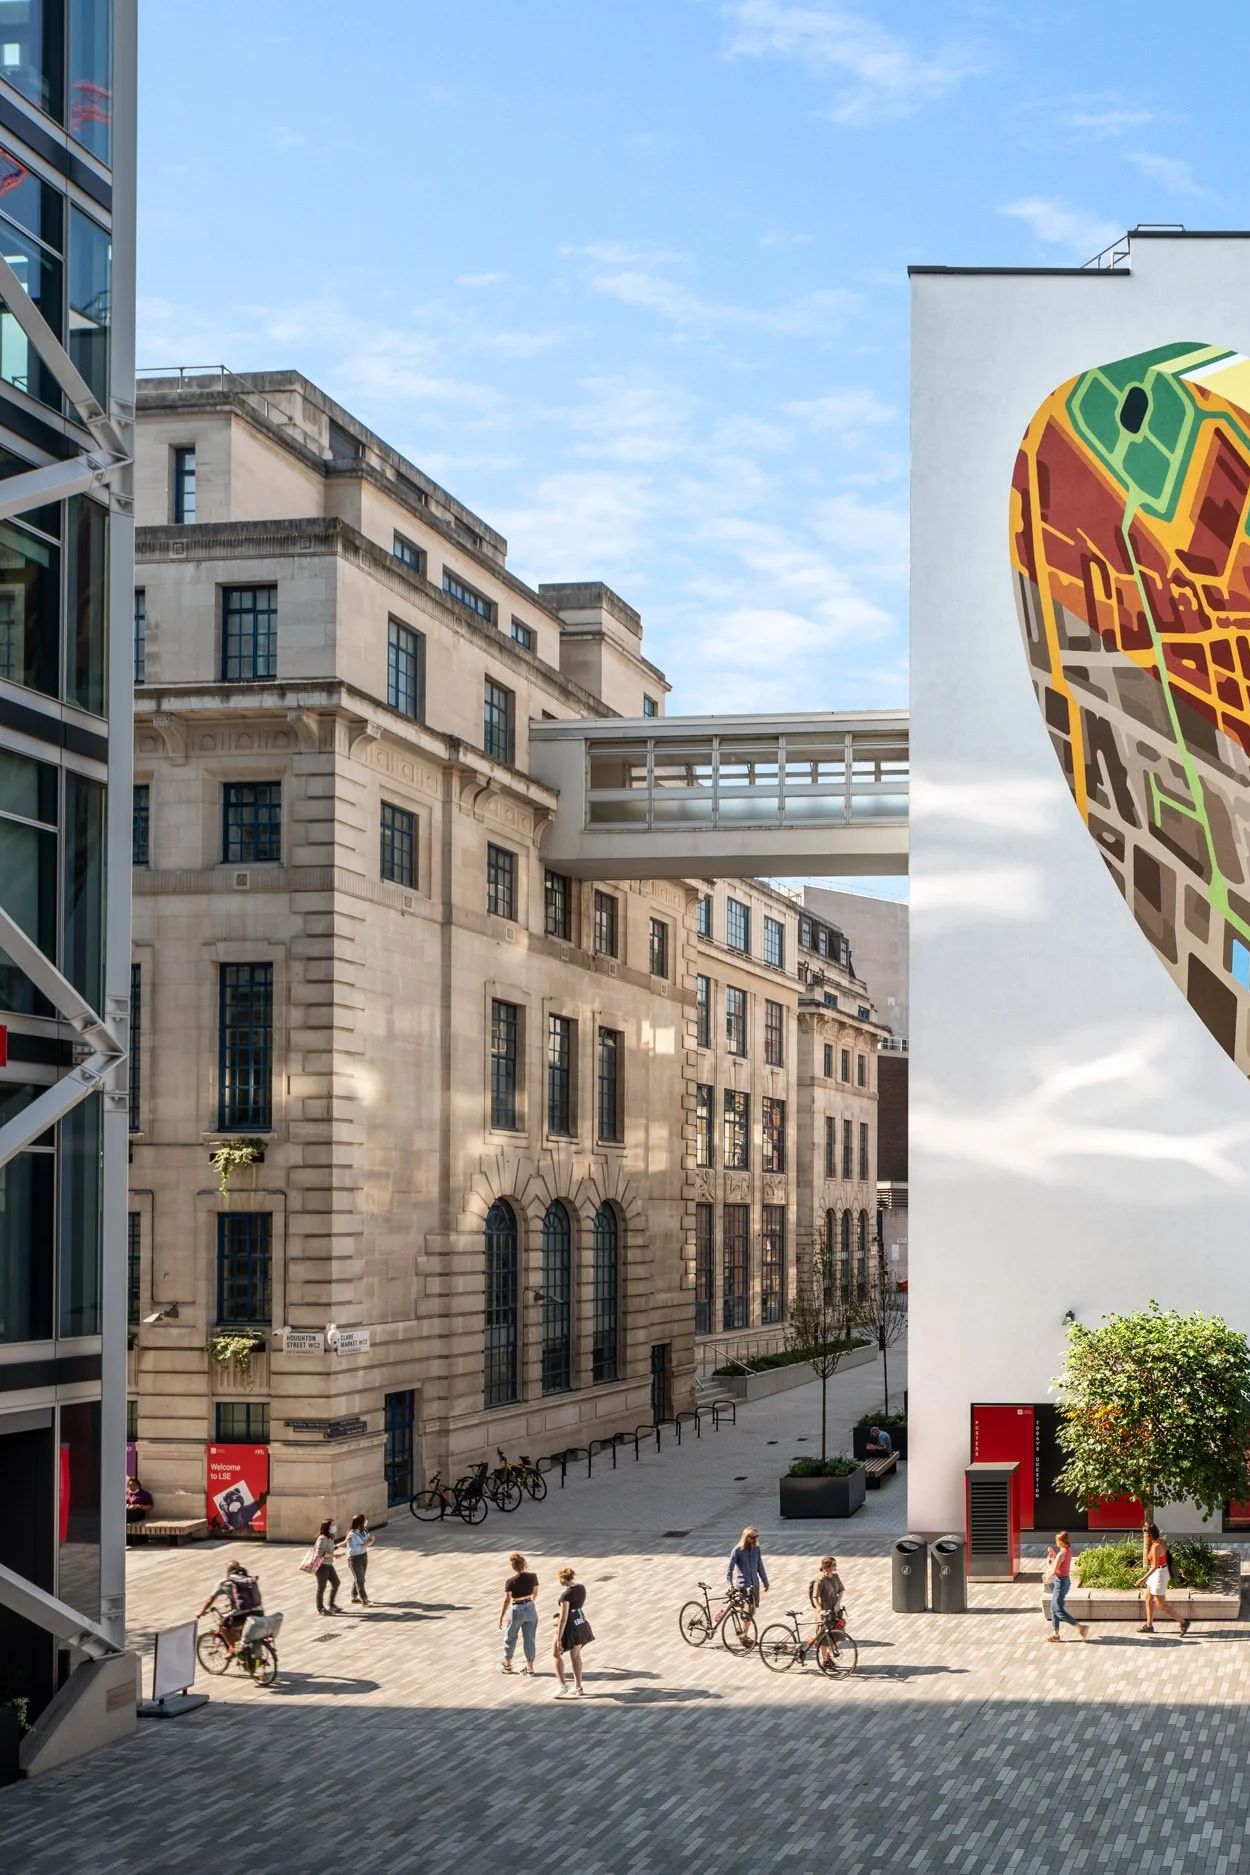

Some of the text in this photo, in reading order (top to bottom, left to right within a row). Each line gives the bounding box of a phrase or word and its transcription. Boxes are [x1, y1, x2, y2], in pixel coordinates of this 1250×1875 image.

[340, 1333, 354, 1341] CLARE
[340, 1340, 358, 1348] MARKET
[210, 1463, 241, 1471] Welcome
[210, 1472, 232, 1480] to LSE
